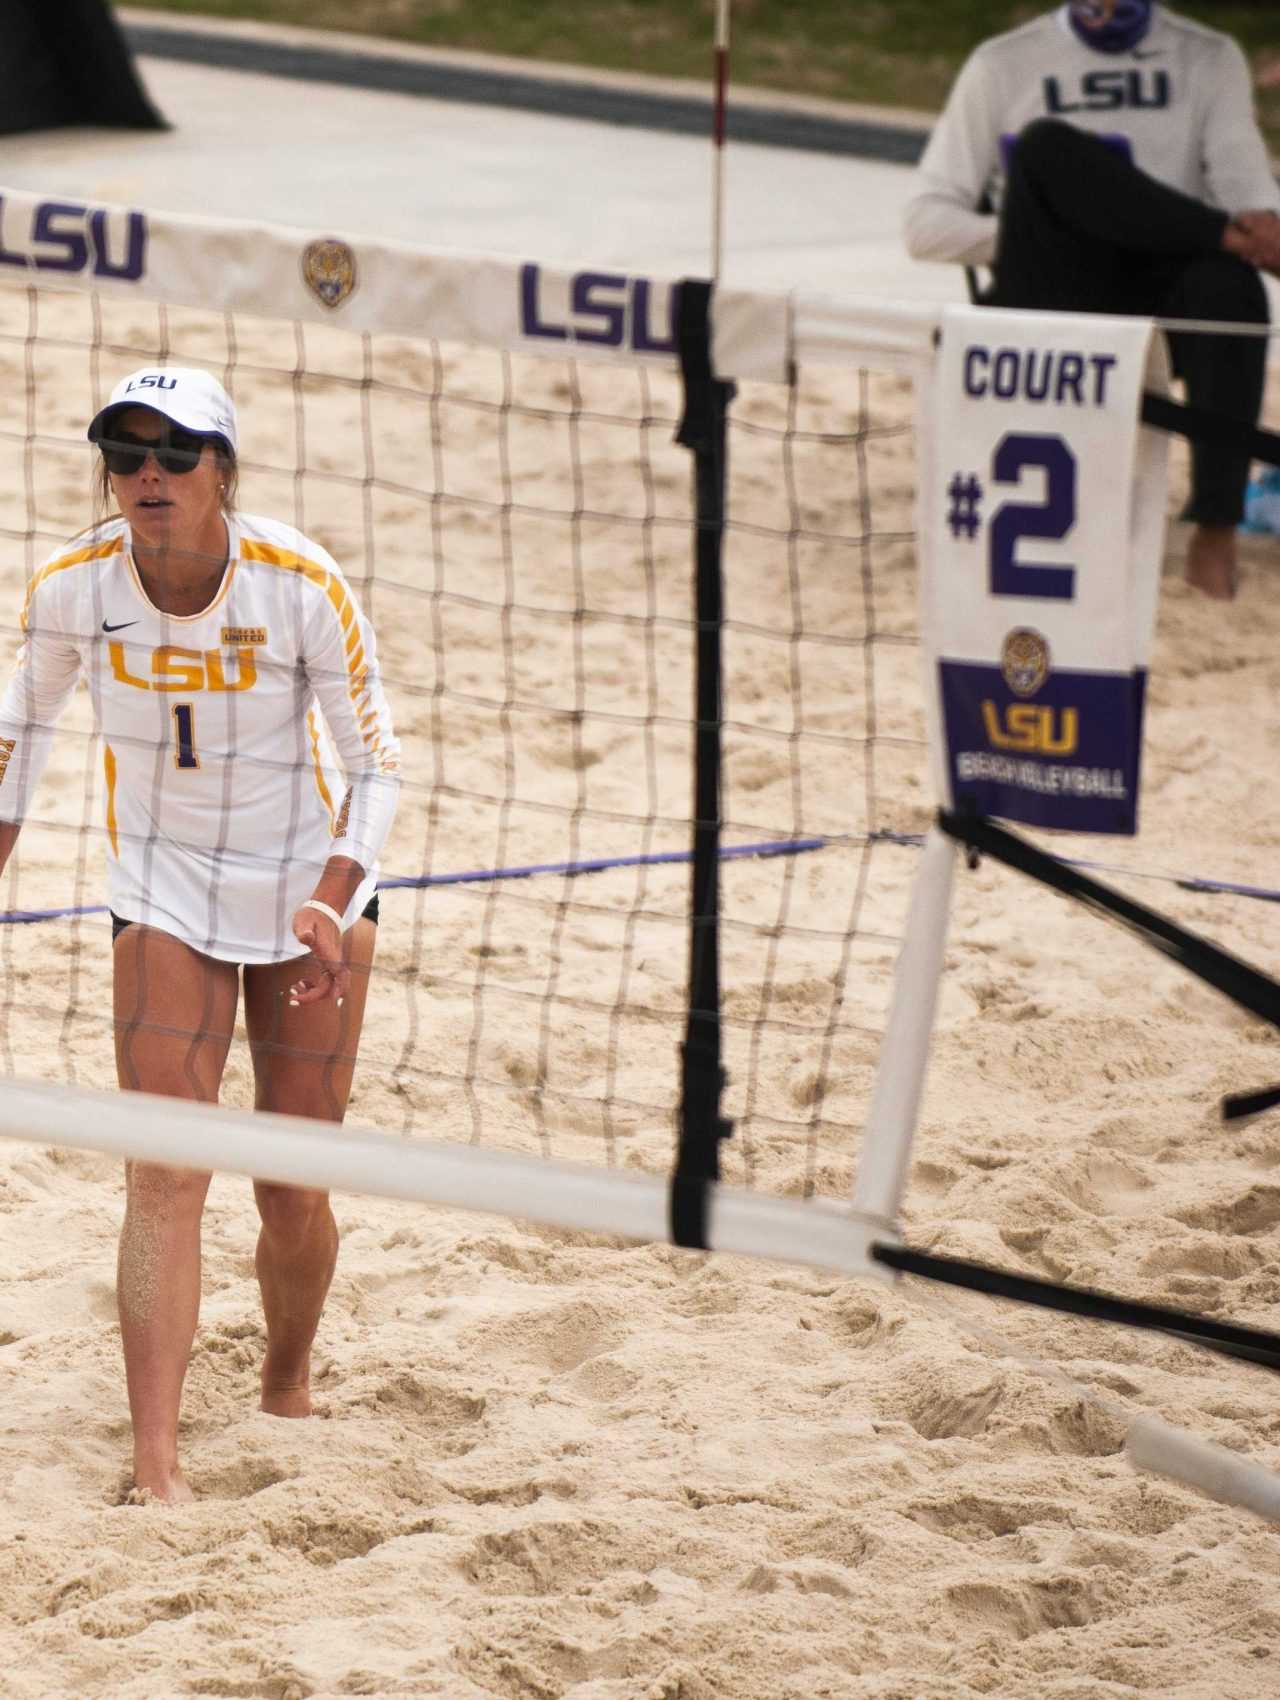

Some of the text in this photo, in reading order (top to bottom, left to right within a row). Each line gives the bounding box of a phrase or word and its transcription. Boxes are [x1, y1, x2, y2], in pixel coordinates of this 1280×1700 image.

[1043, 70, 1169, 113] LSU
[521, 264, 680, 353] LSU
[125, 376, 177, 393] LSU
[965, 346, 1117, 406] COURT
[947, 431, 1077, 602] #2
[225, 634, 265, 642] UNITED
[108, 640, 257, 692] LSU
[172, 702, 200, 770] 1
[981, 700, 1079, 754] LSU
